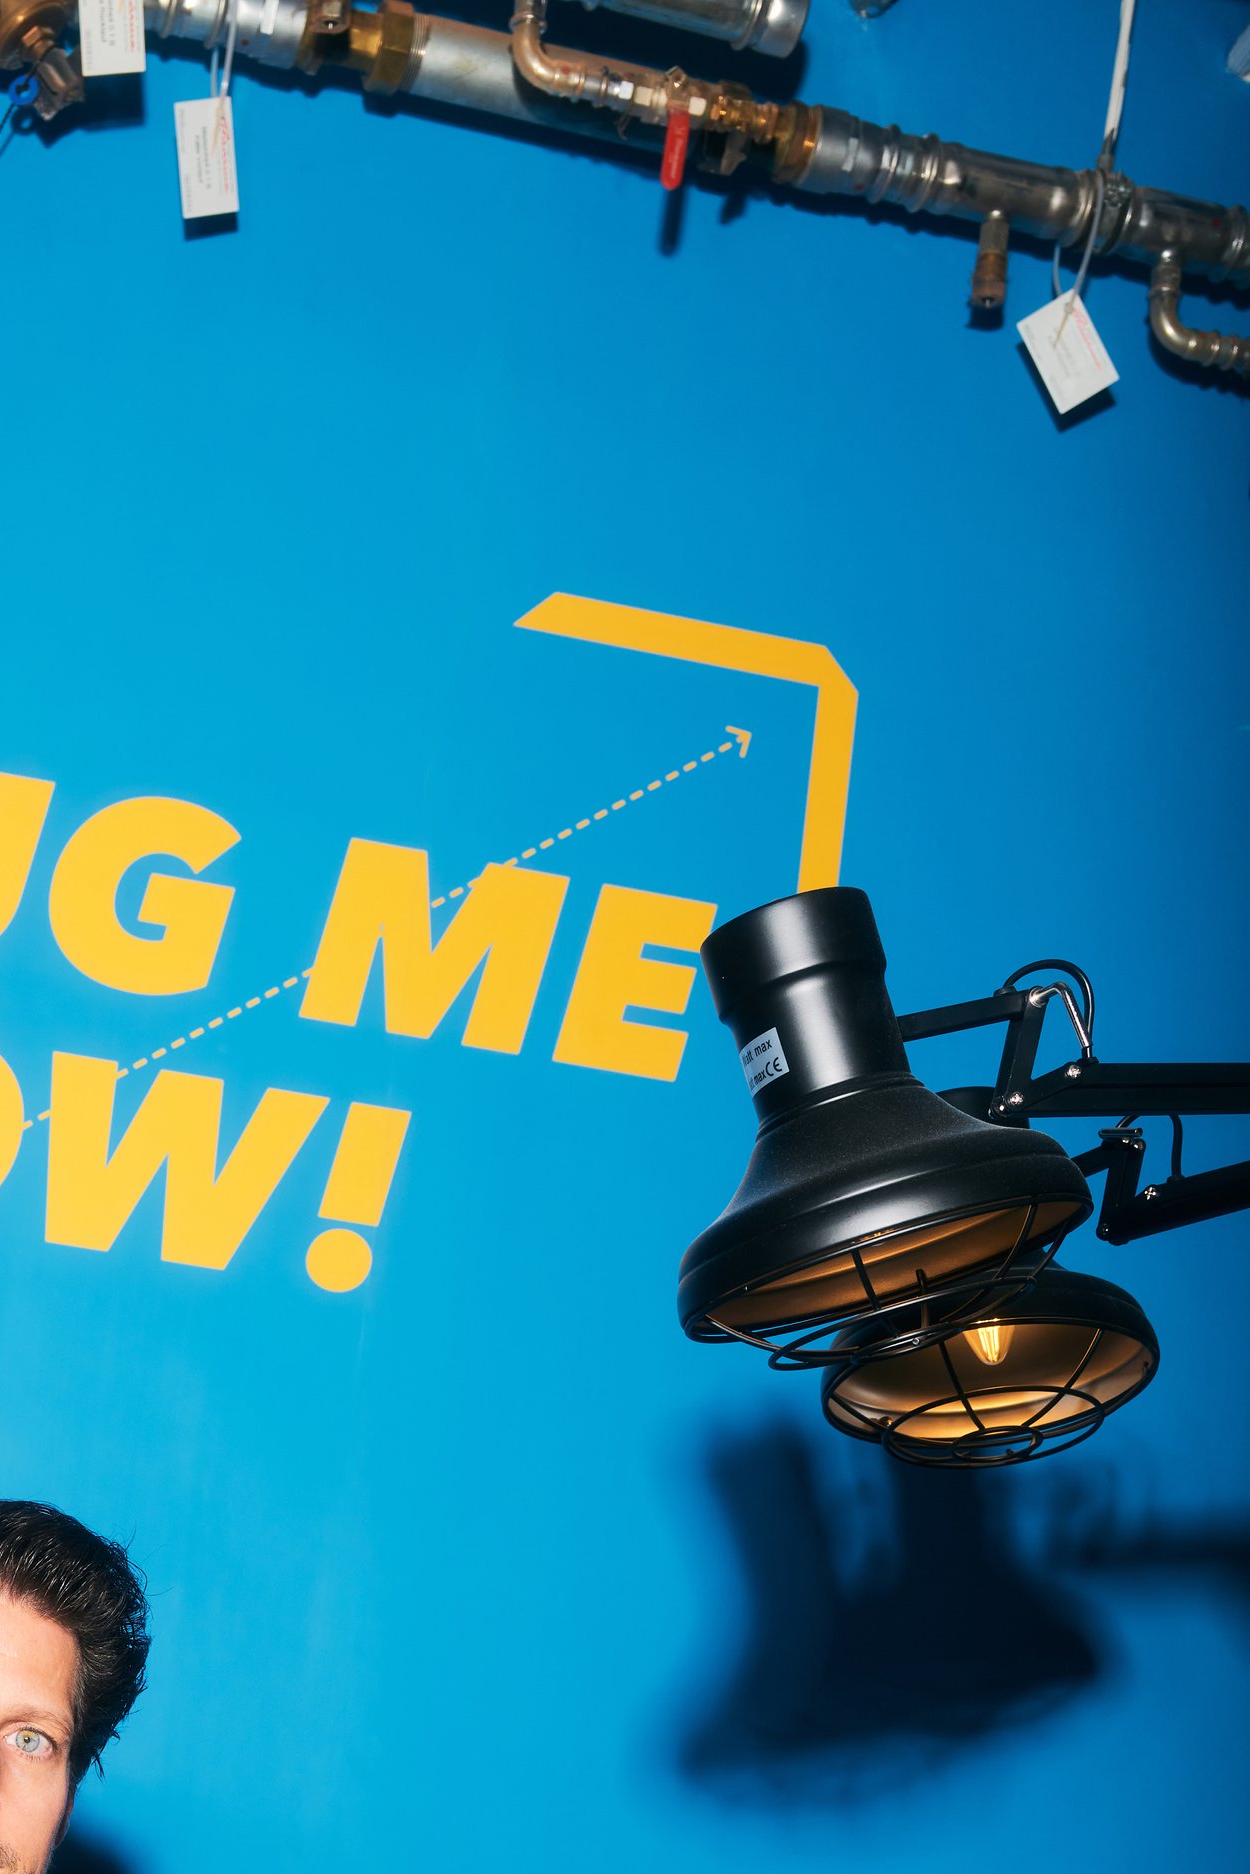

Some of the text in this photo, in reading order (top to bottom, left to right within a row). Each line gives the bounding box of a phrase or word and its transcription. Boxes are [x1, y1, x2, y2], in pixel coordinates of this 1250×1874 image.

[299, 837, 717, 1081] ME
[754, 1040, 772, 1057] max
[753, 1070, 767, 1085] max
